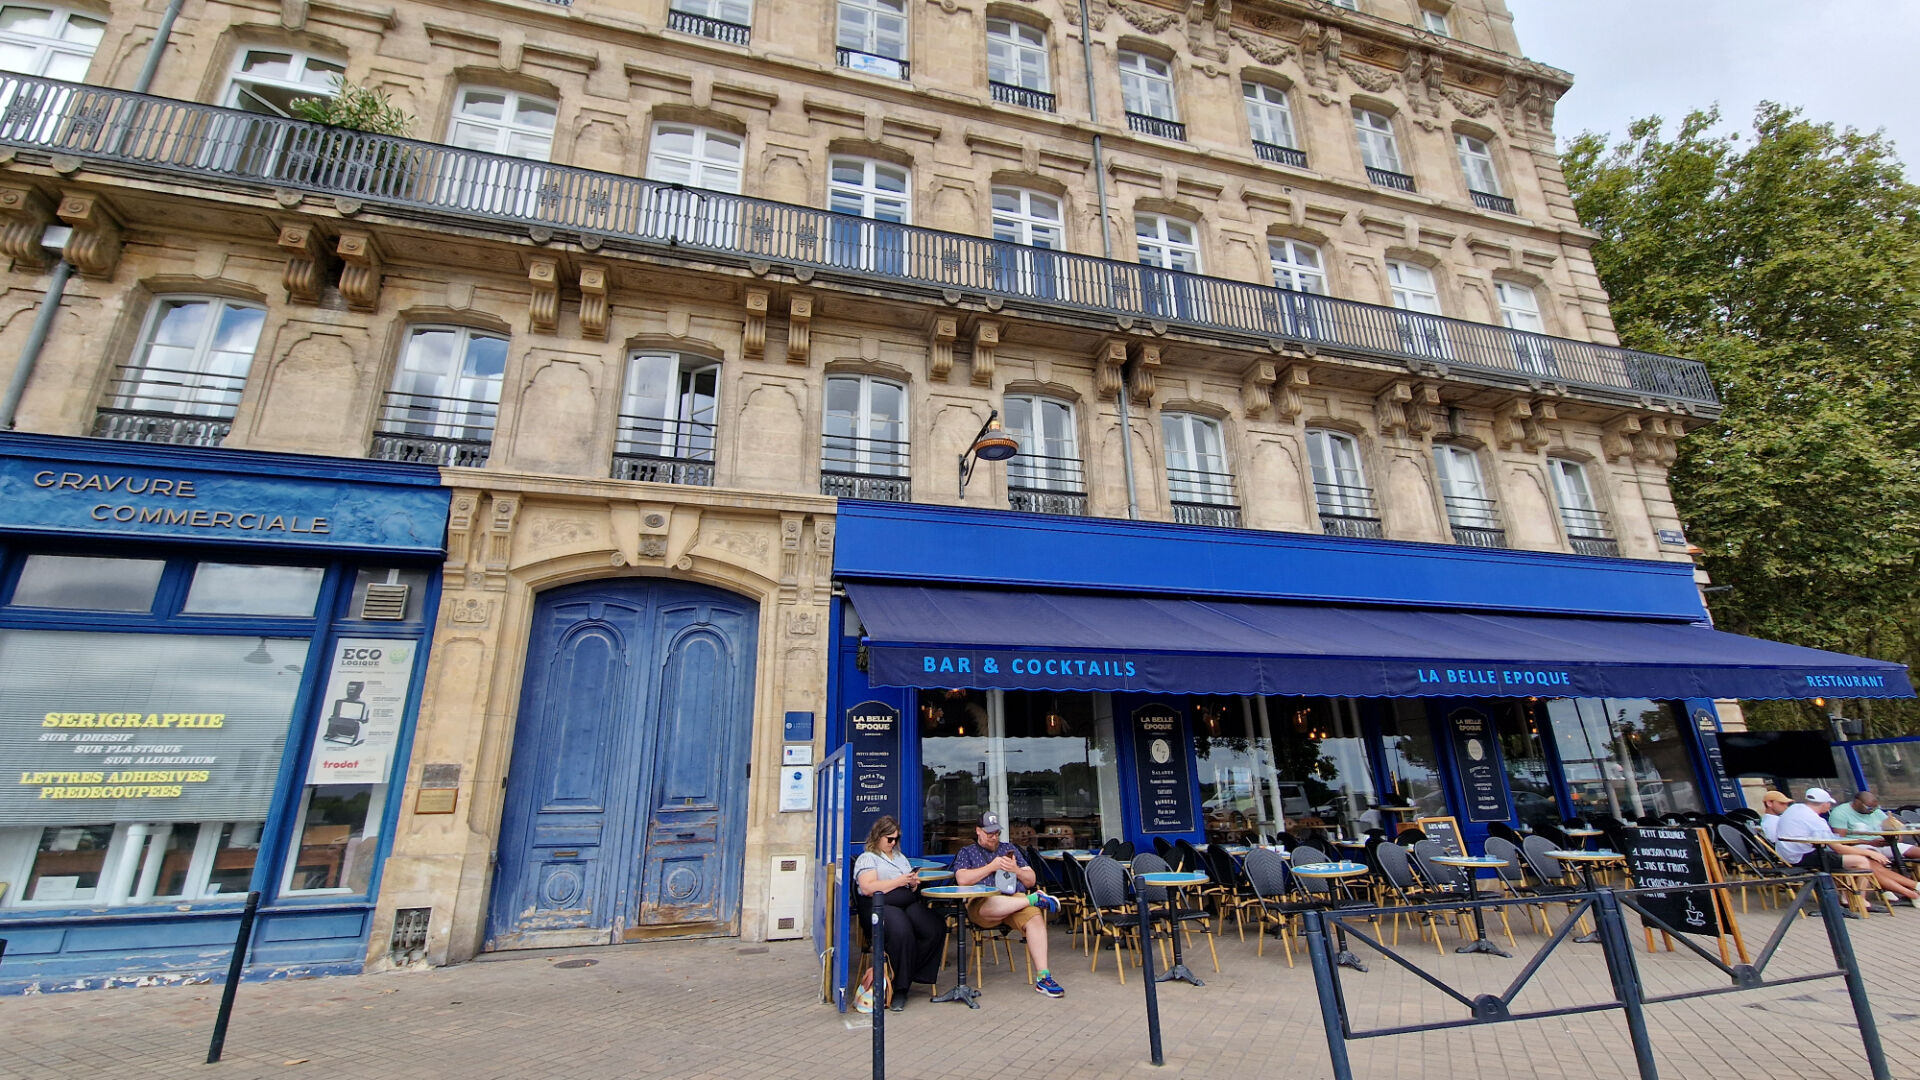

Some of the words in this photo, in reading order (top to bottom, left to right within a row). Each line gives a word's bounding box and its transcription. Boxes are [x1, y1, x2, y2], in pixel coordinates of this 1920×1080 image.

[33, 470, 197, 498] GRAVURE
[91, 504, 330, 534] COMMERCIALE
[342, 648, 382, 660] ECO
[923, 656, 971, 673] BAR
[983, 657, 999, 674] &
[1012, 658, 1136, 677] COCKTAILS
[1418, 669, 1440, 683] LA
[1446, 669, 1497, 684] BELLE
[1503, 671, 1570, 686] EPOQUE
[1806, 675, 1884, 688] RESTAURANT
[42, 712, 225, 729] SERIGRAPHIE
[856, 722, 890, 730] ÉPOQUE
[39, 733, 69, 742] SUR
[71, 733, 135, 742] ADHESIF
[74, 745, 105, 753] SUR
[107, 745, 184, 754] PLASTIQUE
[104, 756, 133, 764] SUR
[135, 756, 217, 764] ALUMINIUM
[323, 760, 359, 769] trodat
[20, 771, 104, 784] LETTRES
[107, 770, 210, 783] ADHESIVES
[39, 785, 183, 799] PREDECOUPEES
[1640, 829, 1656, 838] PETIT
[1632, 847, 1640, 856] 1
[1641, 848, 1665, 857] BOISSON
[1665, 848, 1689, 859] CHAUDE
[1635, 860, 1644, 870] 1
[1643, 861, 1657, 870] JUS
[1657, 862, 1666, 871] DE
[1666, 862, 1690, 873] FRUITS
[1639, 876, 1647, 887] 1
